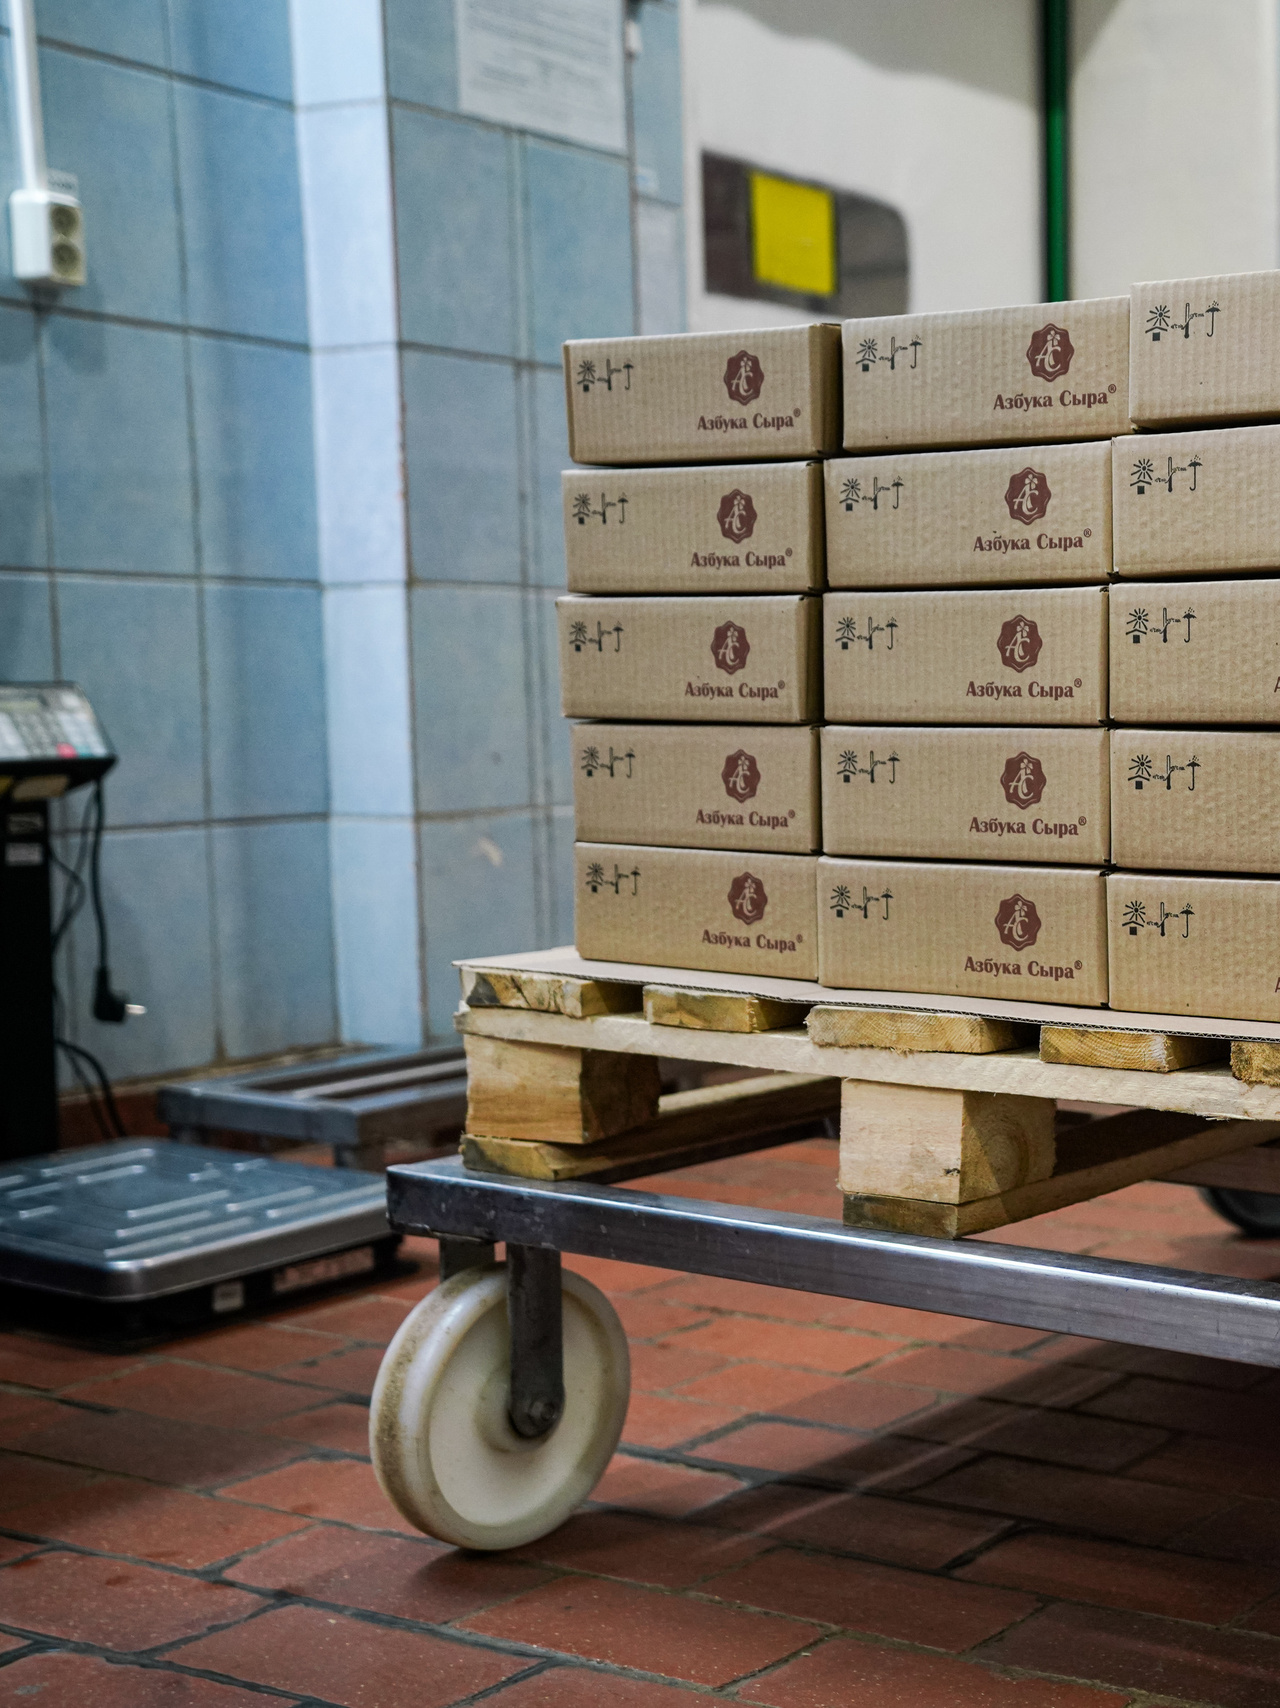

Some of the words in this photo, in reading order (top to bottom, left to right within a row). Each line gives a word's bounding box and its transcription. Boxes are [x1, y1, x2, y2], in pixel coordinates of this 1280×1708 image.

[994, 394, 1053, 411] Азбука
[697, 415, 747, 433] Азбука
[973, 535, 1030, 554] Азбука
[691, 552, 740, 569] Азбука
[685, 681, 733, 699] Азбука
[966, 681, 1022, 700] Азбука
[696, 809, 744, 827] Азбука
[969, 816, 1026, 836] Азбука
[702, 930, 751, 948] Азбука
[965, 957, 1022, 976] Азбука
